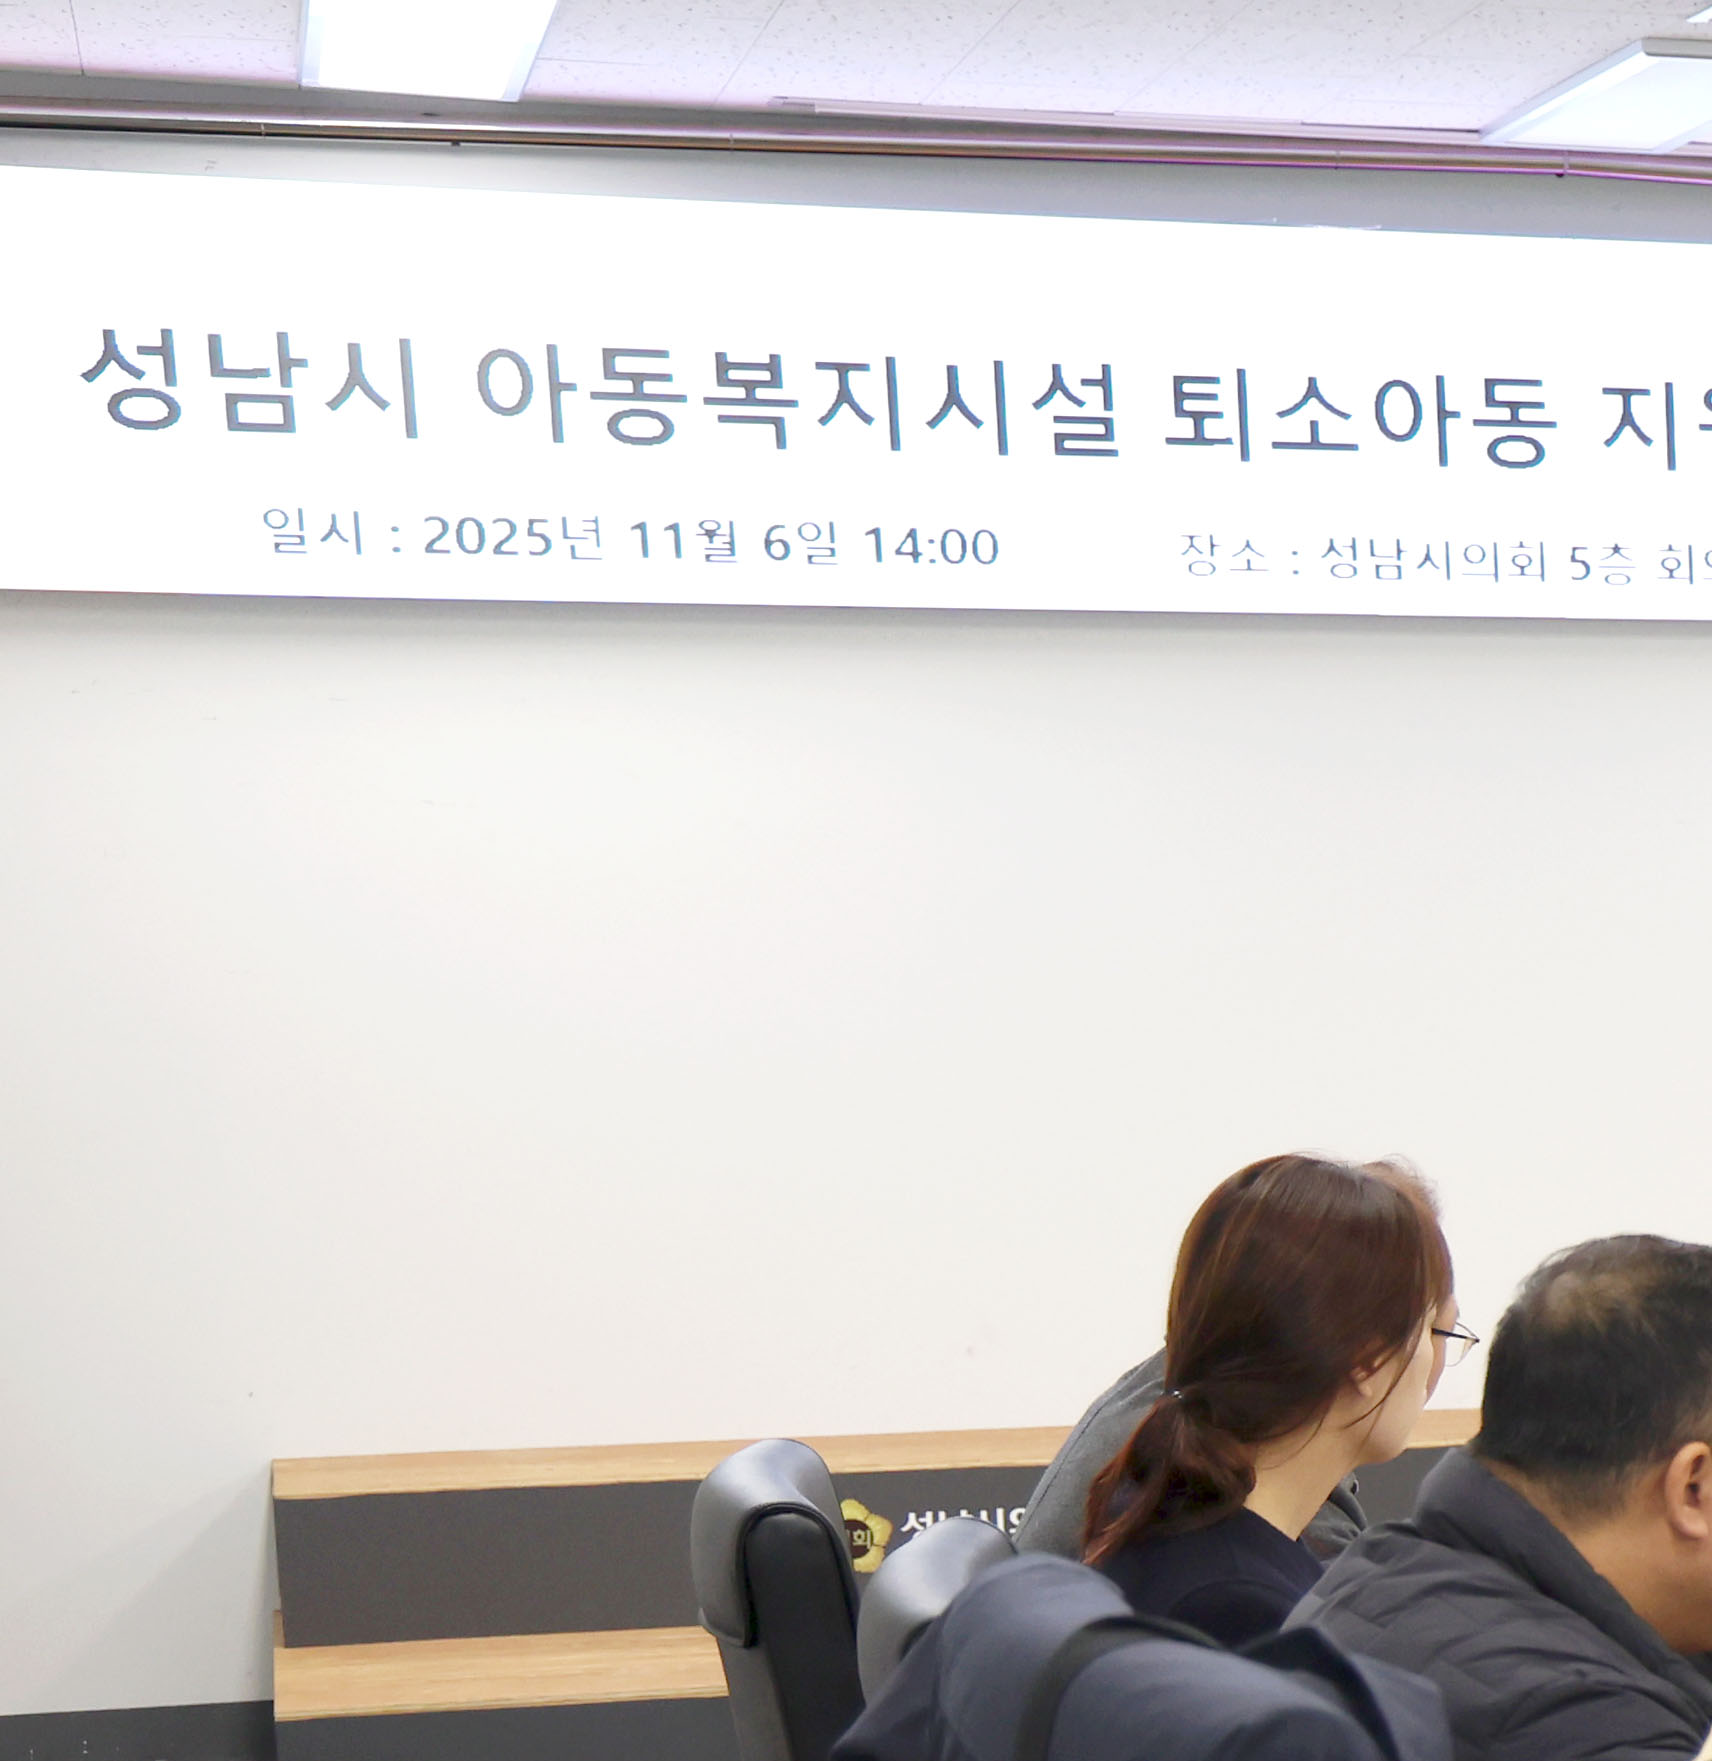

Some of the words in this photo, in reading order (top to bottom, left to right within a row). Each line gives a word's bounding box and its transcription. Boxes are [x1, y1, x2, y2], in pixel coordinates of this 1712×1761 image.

[80, 328, 418, 439] 성남시
[477, 344, 1119, 457] 아동복지시설
[1165, 368, 1558, 469] 퇴소아동
[262, 508, 363, 556] 일시
[423, 516, 603, 560] 2025년
[630, 519, 737, 564] 11월
[763, 520, 838, 566] 6일
[864, 526, 1000, 566] 14:00
[1180, 533, 1269, 577] 장소
[1320, 536, 1546, 584] 성남시의회
[1569, 543, 1636, 586] 5층
